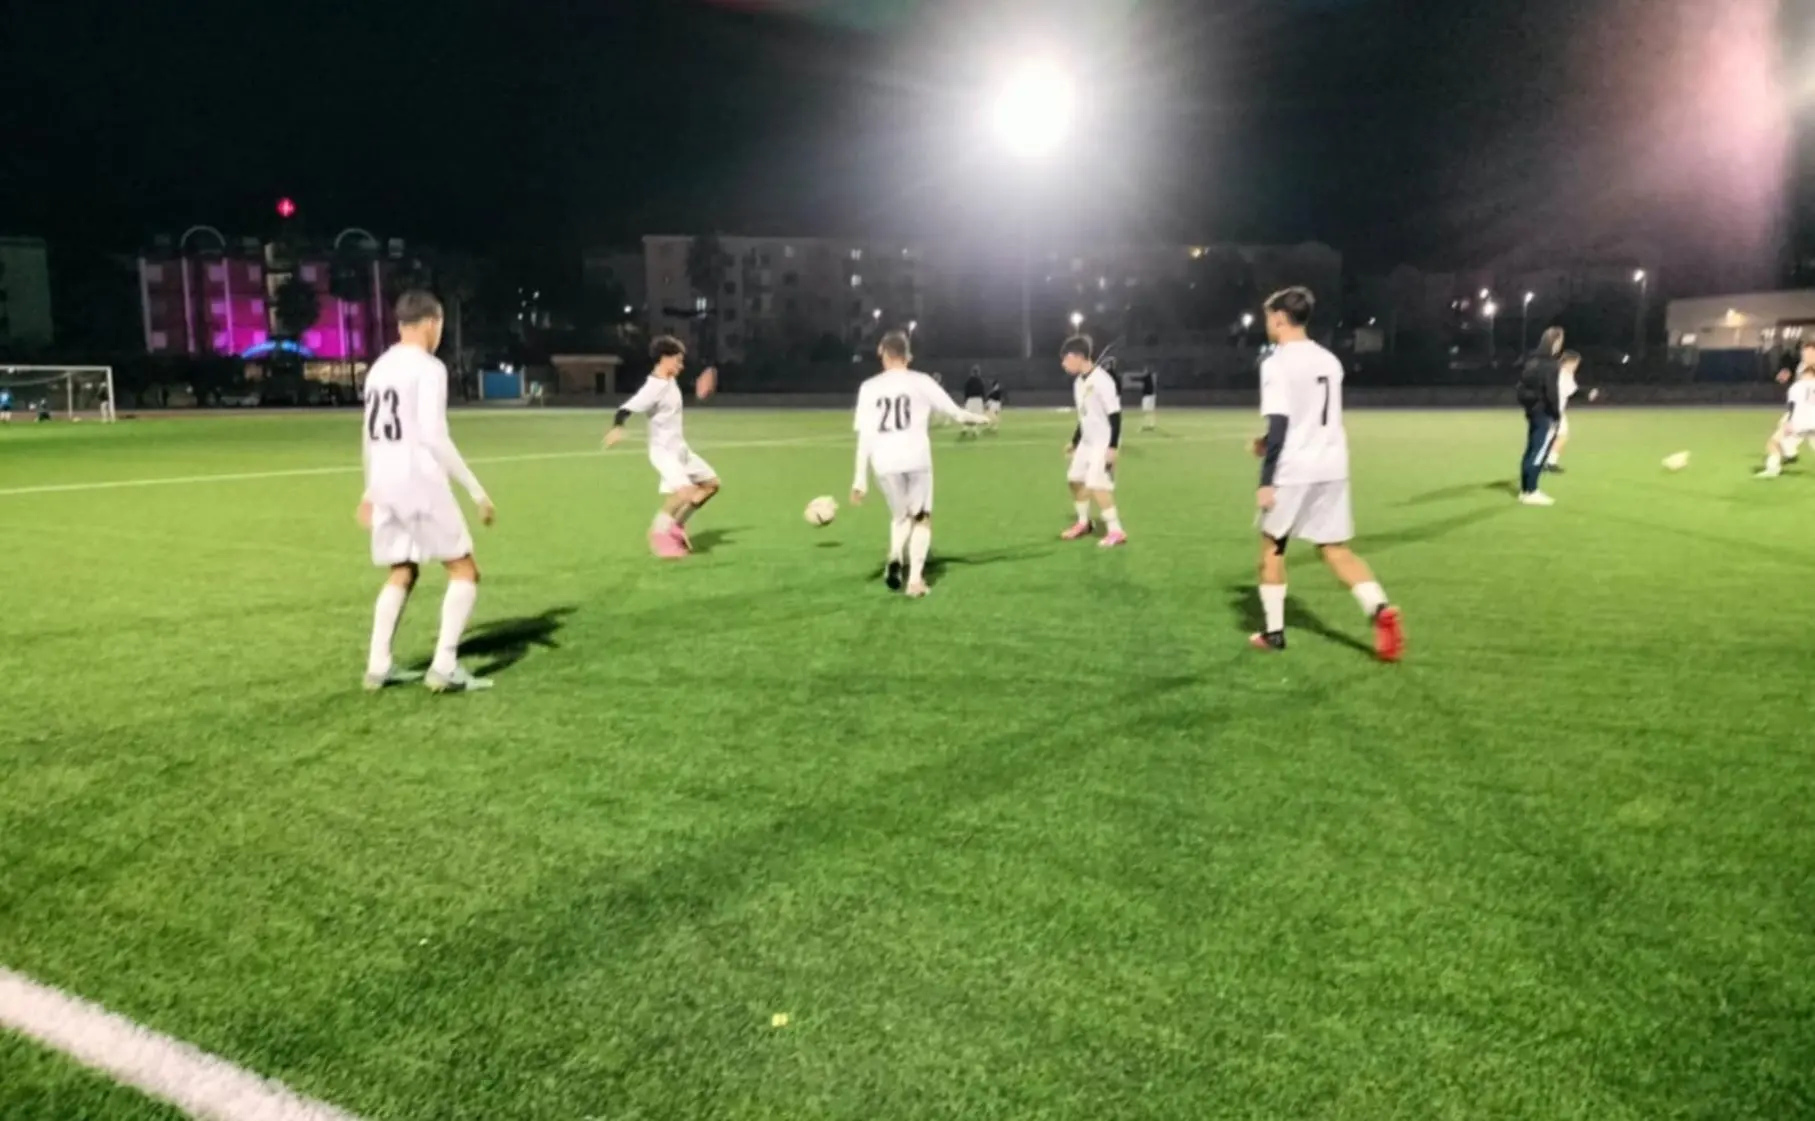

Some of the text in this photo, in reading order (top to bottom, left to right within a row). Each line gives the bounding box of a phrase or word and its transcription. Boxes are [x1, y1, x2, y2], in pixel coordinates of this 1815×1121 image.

[366, 387, 403, 441] 23
[876, 393, 911, 433] 20
[1317, 376, 1329, 427] 7
